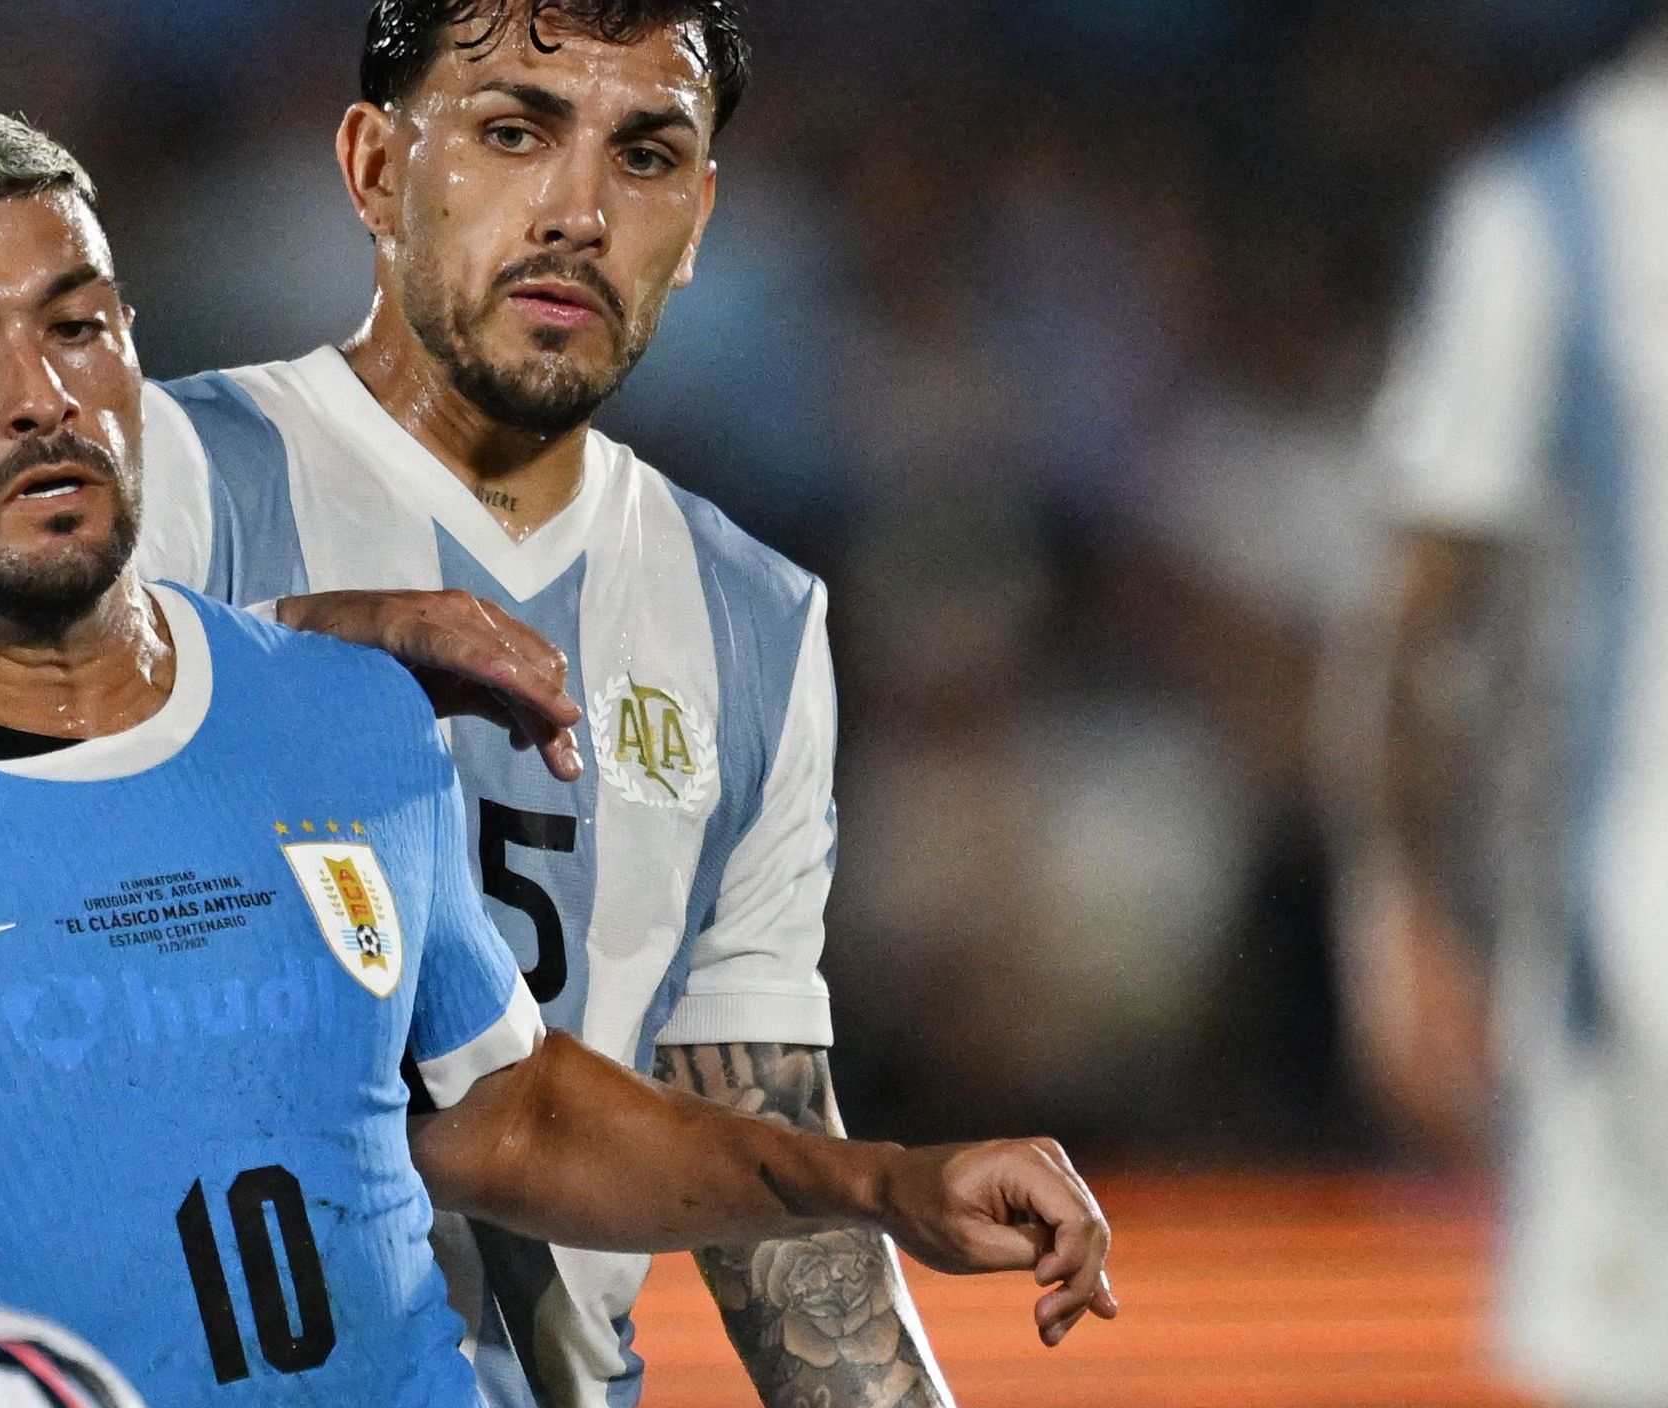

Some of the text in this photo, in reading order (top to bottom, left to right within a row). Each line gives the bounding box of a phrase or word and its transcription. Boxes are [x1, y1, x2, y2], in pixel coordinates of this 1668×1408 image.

[84, 876, 242, 912] URUGUAY VS. ARGENTINA
[120, 871, 197, 891] ELIMINATORIAS
[338, 868, 368, 919] AUF
[479, 797, 578, 1005] 5
[88, 908, 160, 932] CLÁSICO
[162, 900, 199, 922] MÁS
[204, 890, 277, 914] ANTIGUO"
[109, 915, 247, 949] ESTADIO CENTENARIO
[175, 1163, 336, 1386] 10
